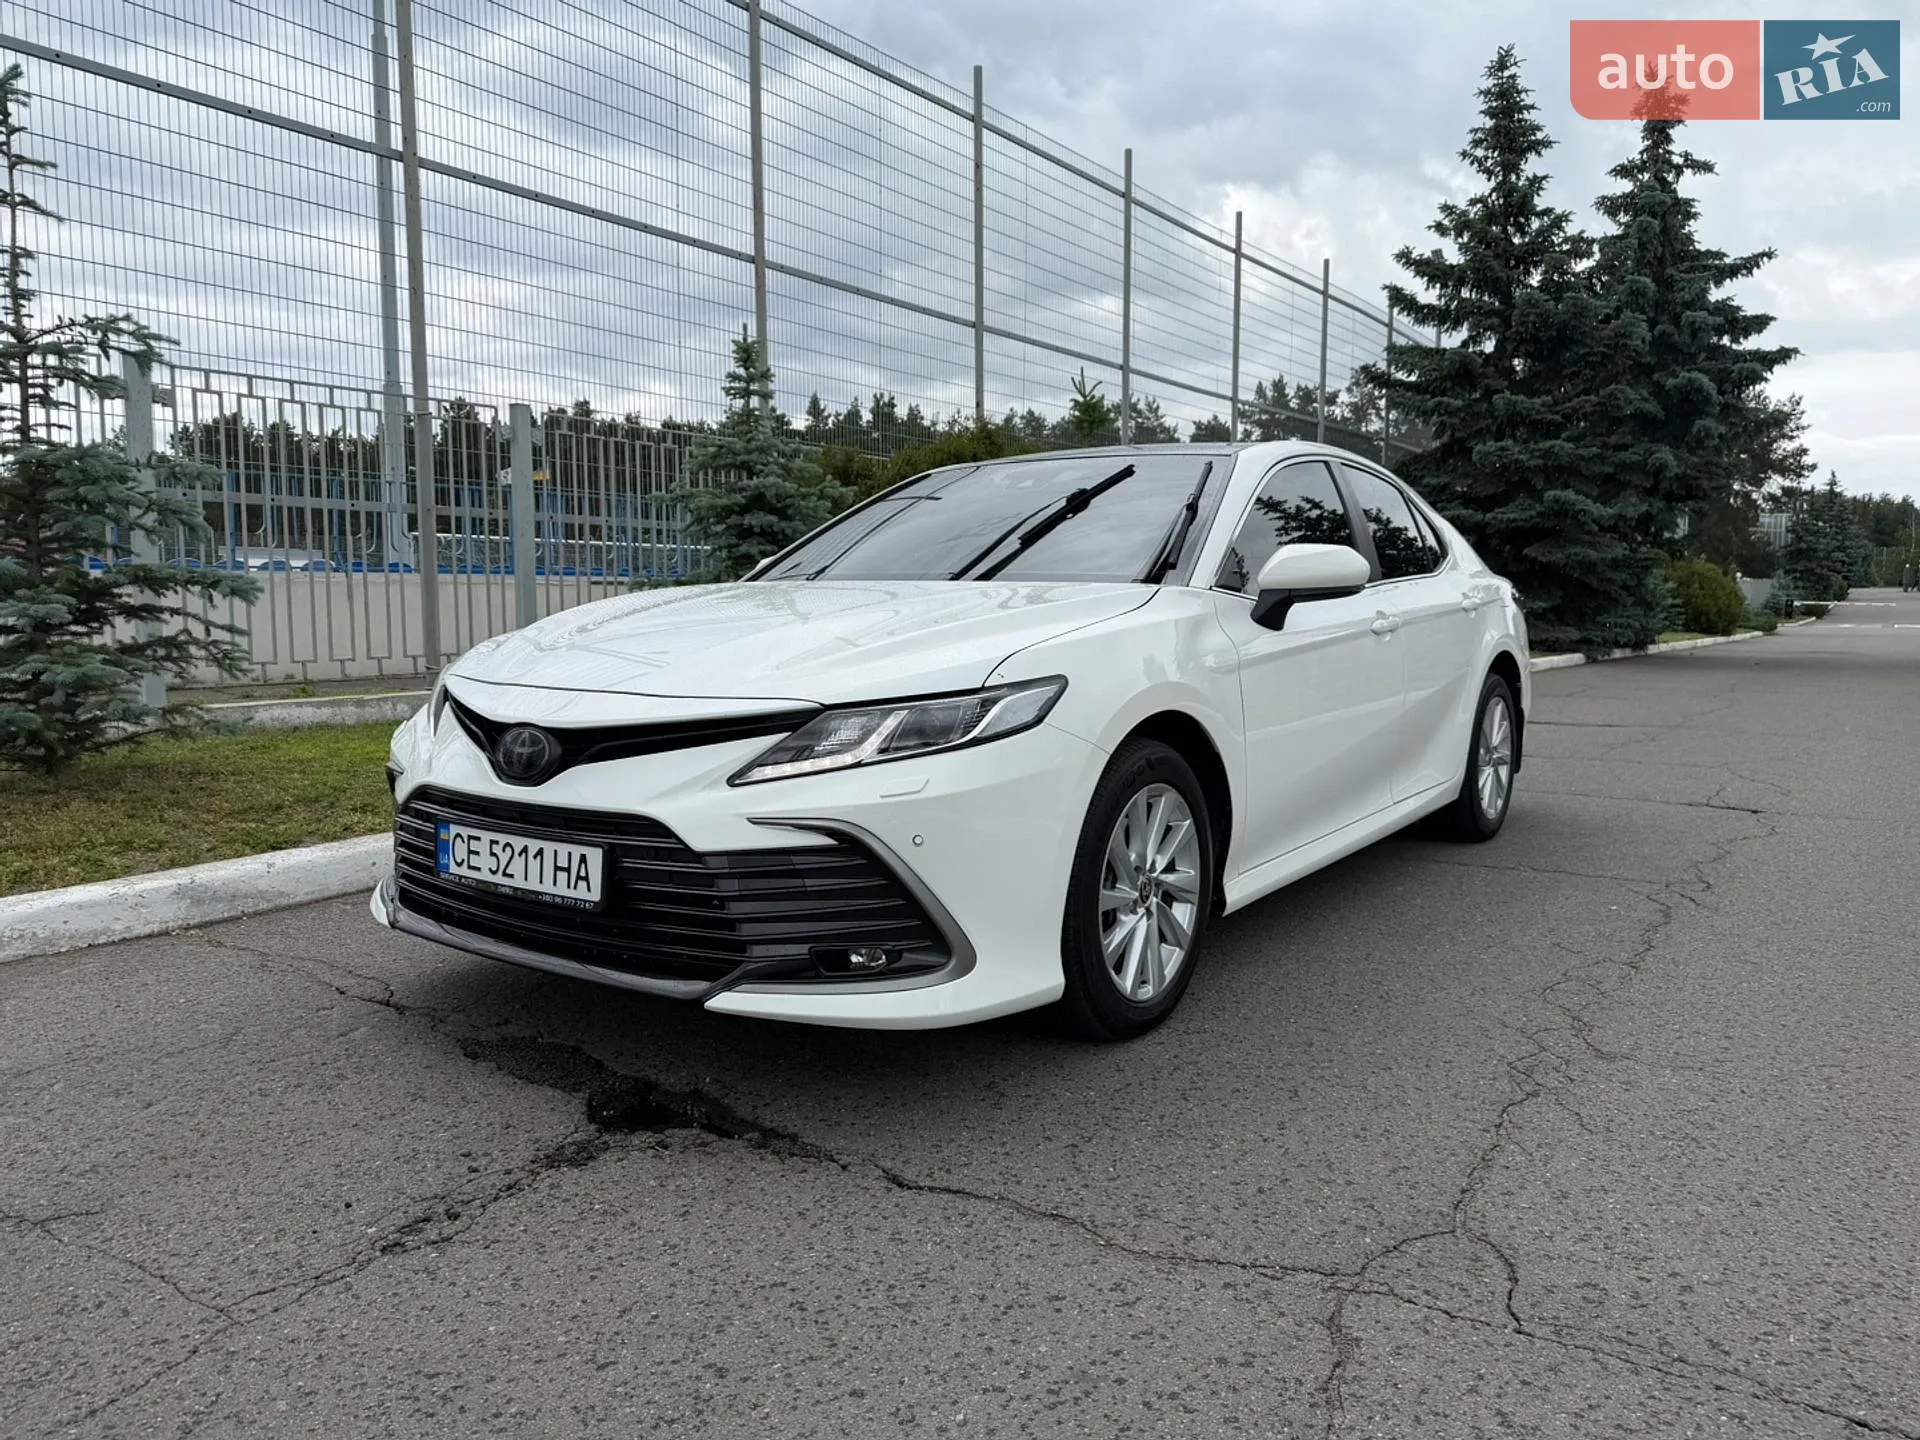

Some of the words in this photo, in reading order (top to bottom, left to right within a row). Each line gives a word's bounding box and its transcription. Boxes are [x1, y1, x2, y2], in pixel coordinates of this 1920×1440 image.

[439, 852, 449, 864] UA
[452, 832, 482, 872] CE
[488, 839, 545, 885] 5211
[553, 849, 592, 893] HA
